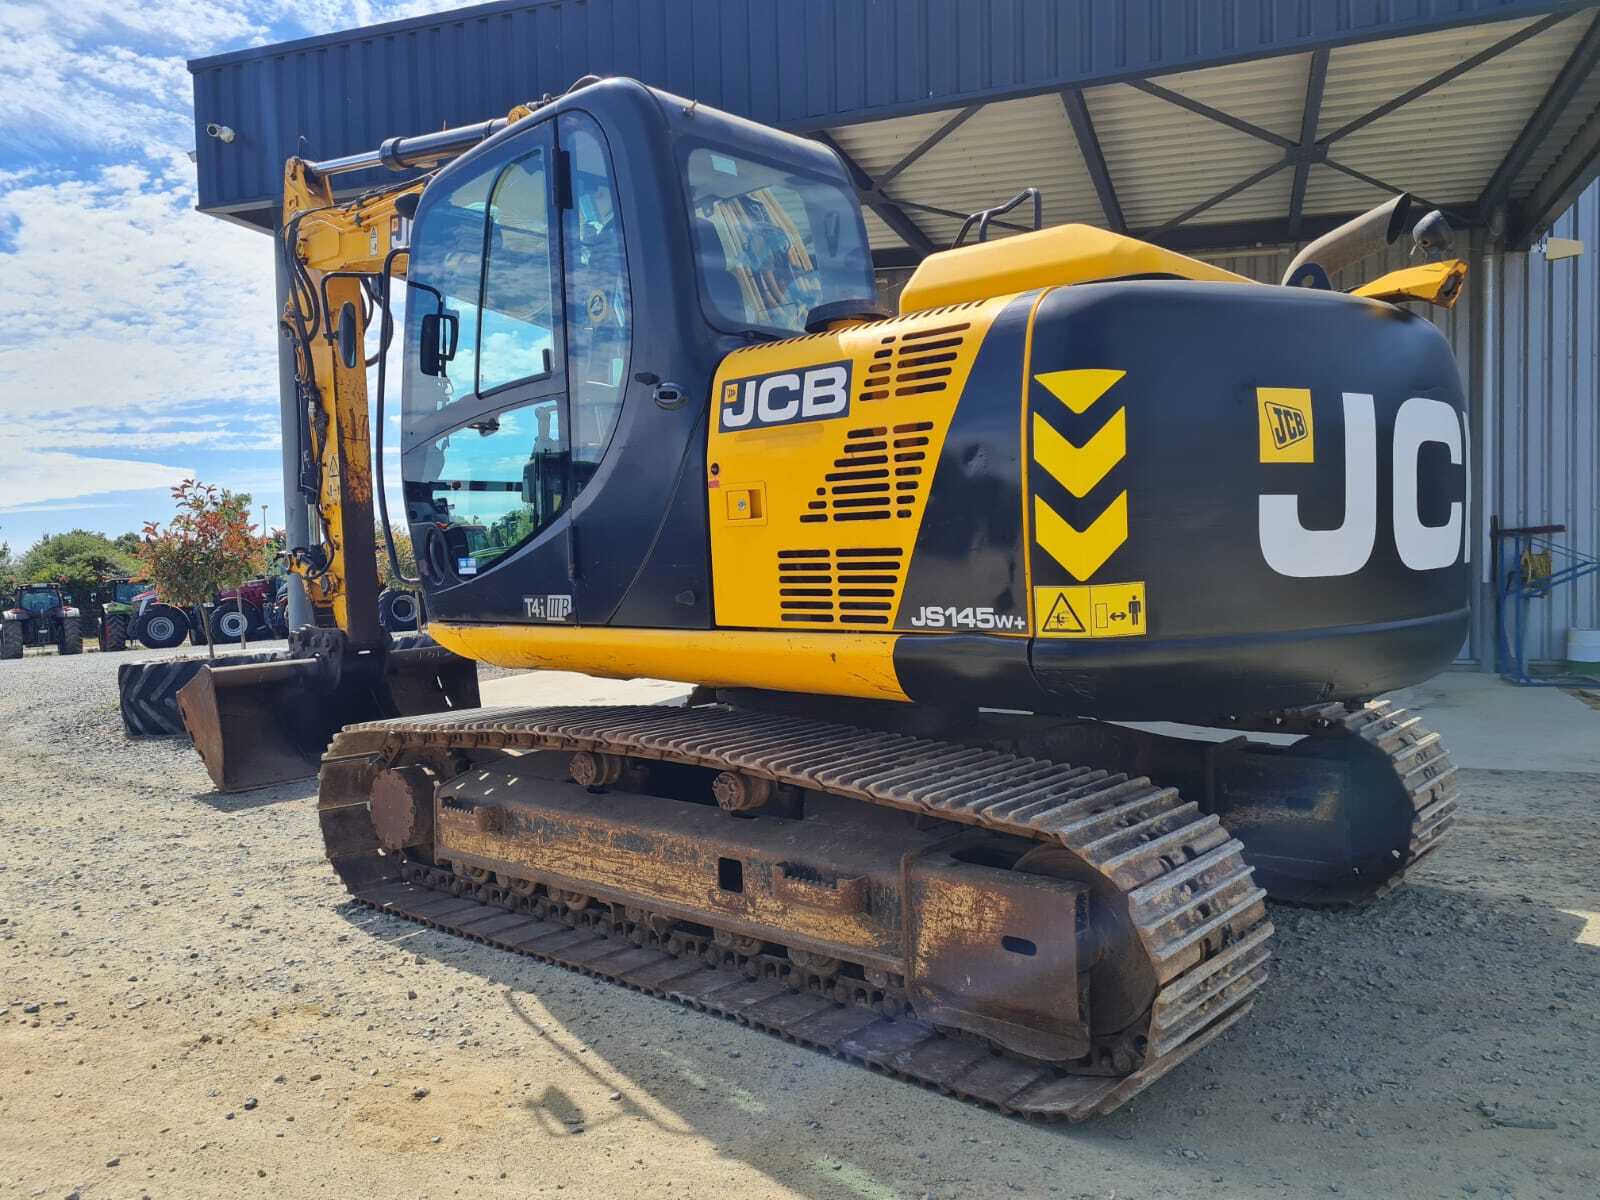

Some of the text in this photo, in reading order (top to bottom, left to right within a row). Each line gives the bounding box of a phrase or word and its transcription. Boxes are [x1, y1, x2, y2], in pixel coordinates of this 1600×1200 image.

[722, 366, 847, 427] JCB
[1272, 406, 1306, 445] JCB
[1258, 392, 1471, 578] JC
